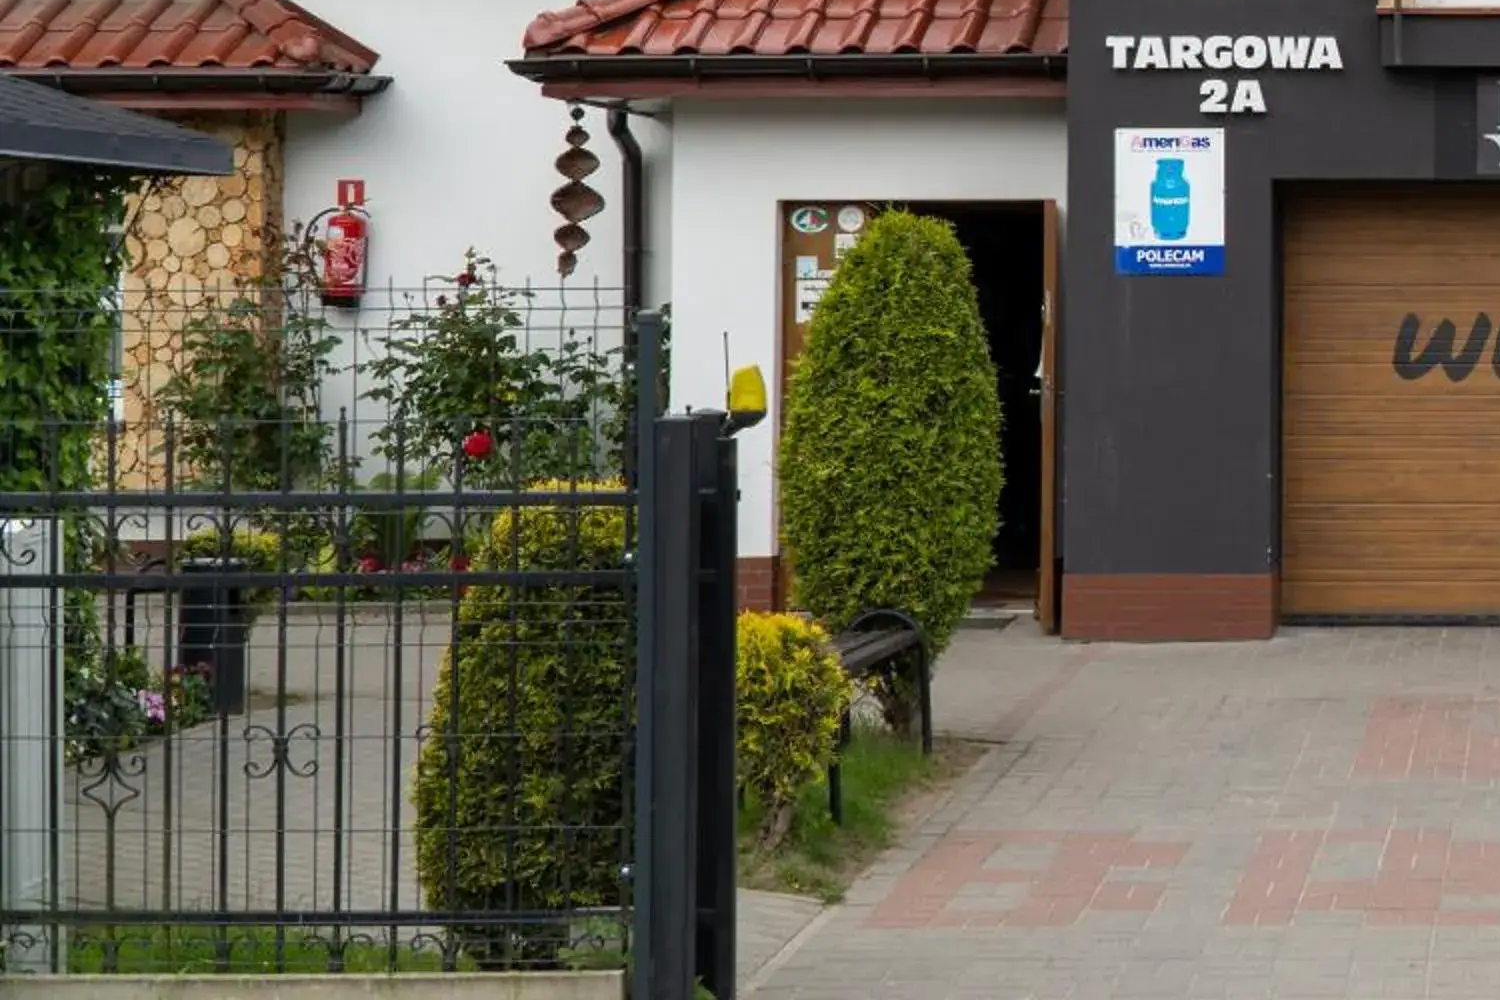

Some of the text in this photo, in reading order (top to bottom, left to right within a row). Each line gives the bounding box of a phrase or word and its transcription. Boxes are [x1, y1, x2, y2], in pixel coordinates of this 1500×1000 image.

[1106, 36, 1343, 69] TARGOWA
[1200, 79, 1267, 113] 2A
[1136, 250, 1204, 262] POLECAM
